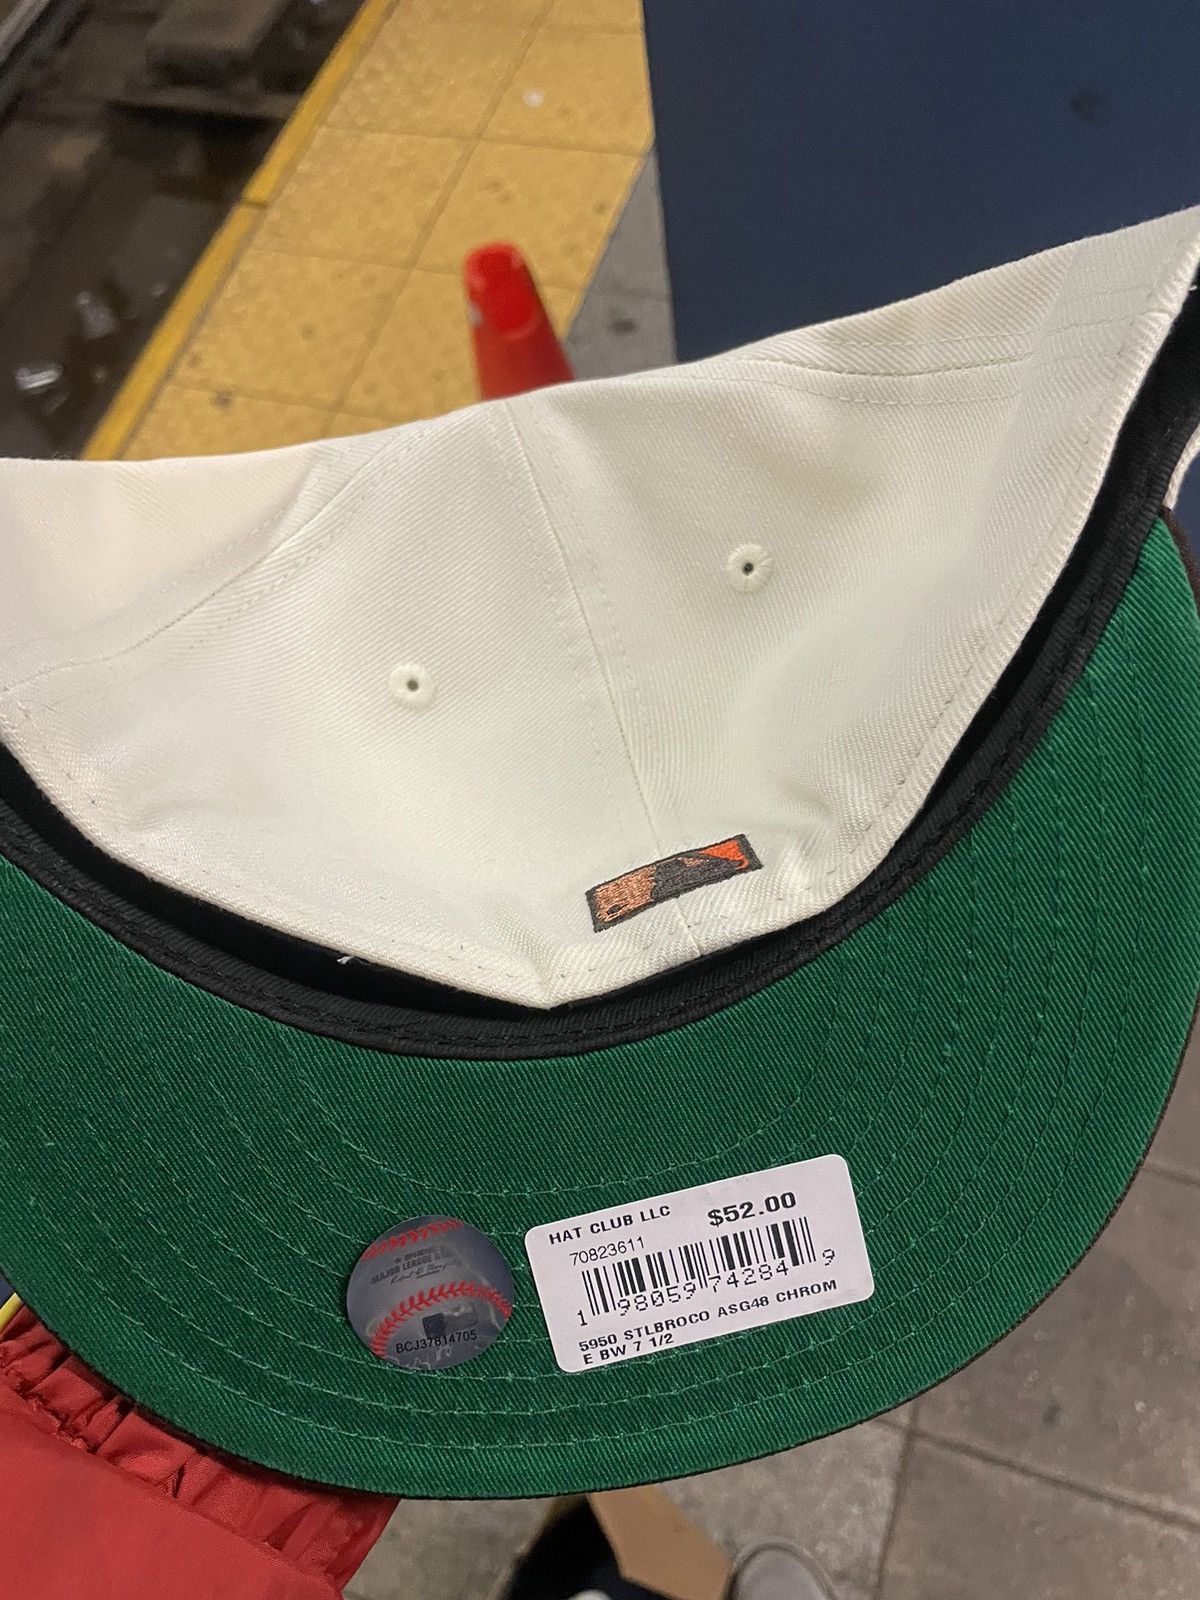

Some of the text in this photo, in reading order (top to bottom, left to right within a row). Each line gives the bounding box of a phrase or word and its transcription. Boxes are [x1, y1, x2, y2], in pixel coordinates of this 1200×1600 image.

[549, 1205, 671, 1245] HAT CLUB LLC
[708, 1192, 797, 1227] $52.00
[569, 1237, 645, 1265] 70823611
[709, 1260, 789, 1293] 74284
[579, 1280, 837, 1352] 5950 STLBROCO ASG48 CHROM
[396, 1330, 477, 1353] BCJ37814705
[583, 1334, 674, 1364] E BW 7 1/2
